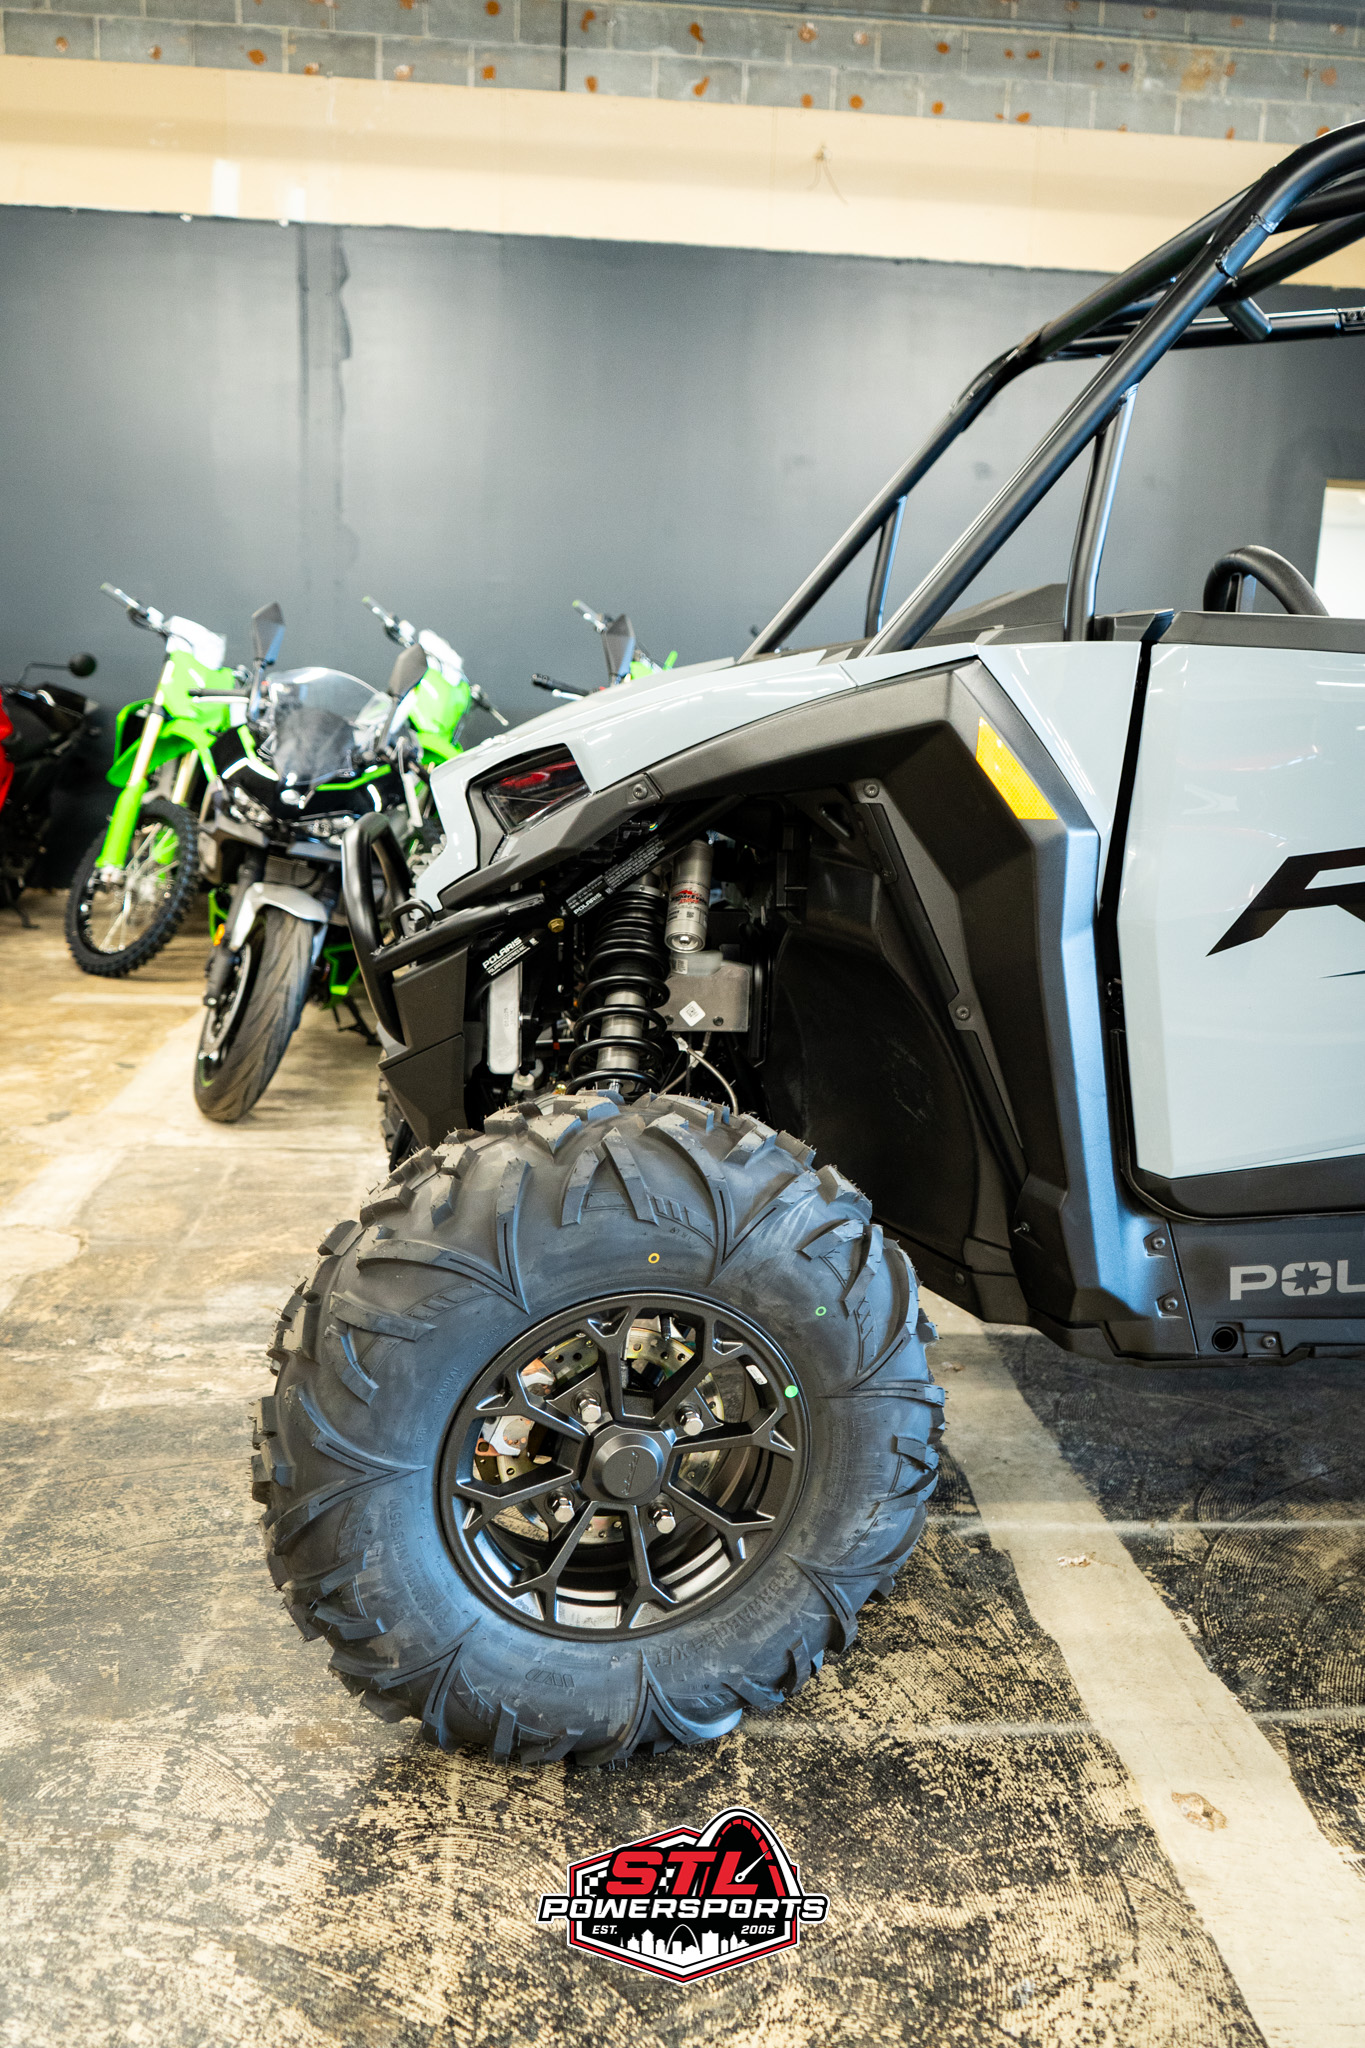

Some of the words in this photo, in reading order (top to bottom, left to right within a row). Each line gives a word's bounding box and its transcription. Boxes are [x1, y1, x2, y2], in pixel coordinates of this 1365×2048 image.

[573, 893, 602, 914] POLARIS
[482, 936, 522, 968] POLARIS
[1229, 1260, 1365, 1300] POL
